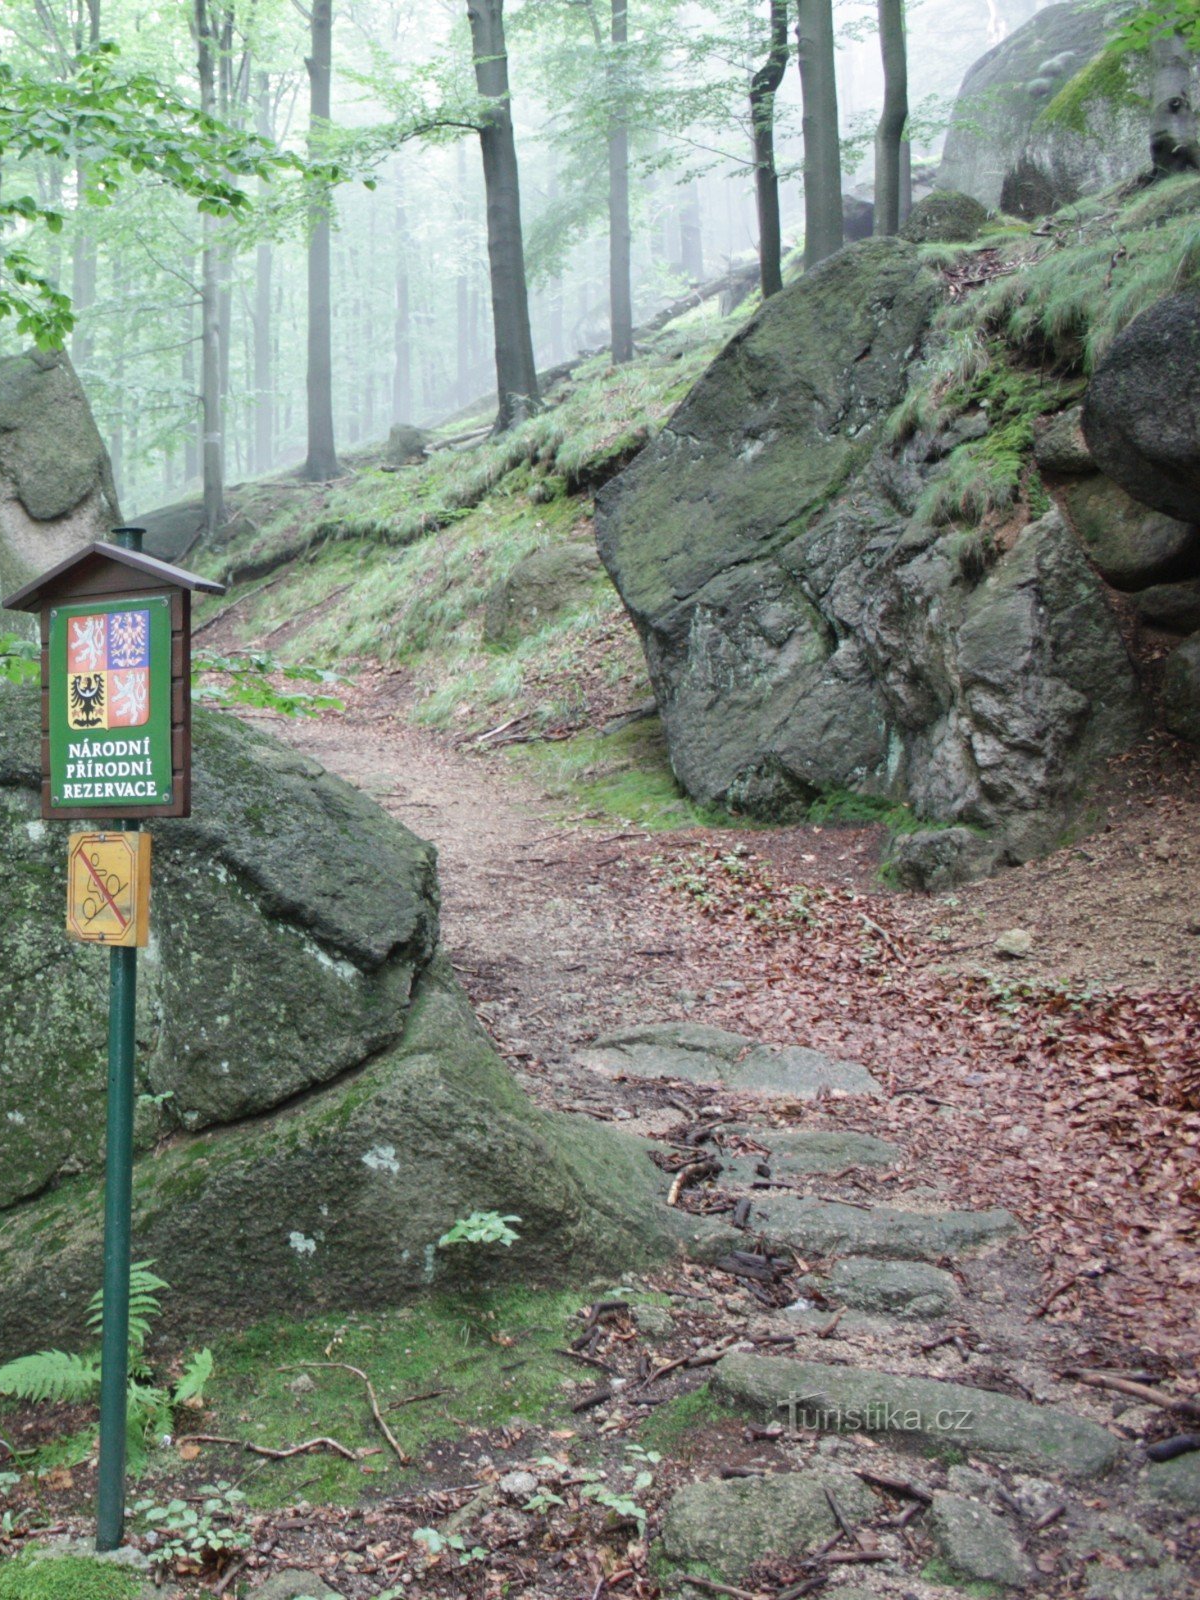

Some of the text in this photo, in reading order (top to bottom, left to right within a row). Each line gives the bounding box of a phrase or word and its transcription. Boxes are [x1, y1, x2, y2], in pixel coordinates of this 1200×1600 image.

[68, 736, 150, 758] NÁRODNÍ
[66, 758, 152, 779] PŘÍRODNÍ
[63, 781, 157, 799] REZERVACE
